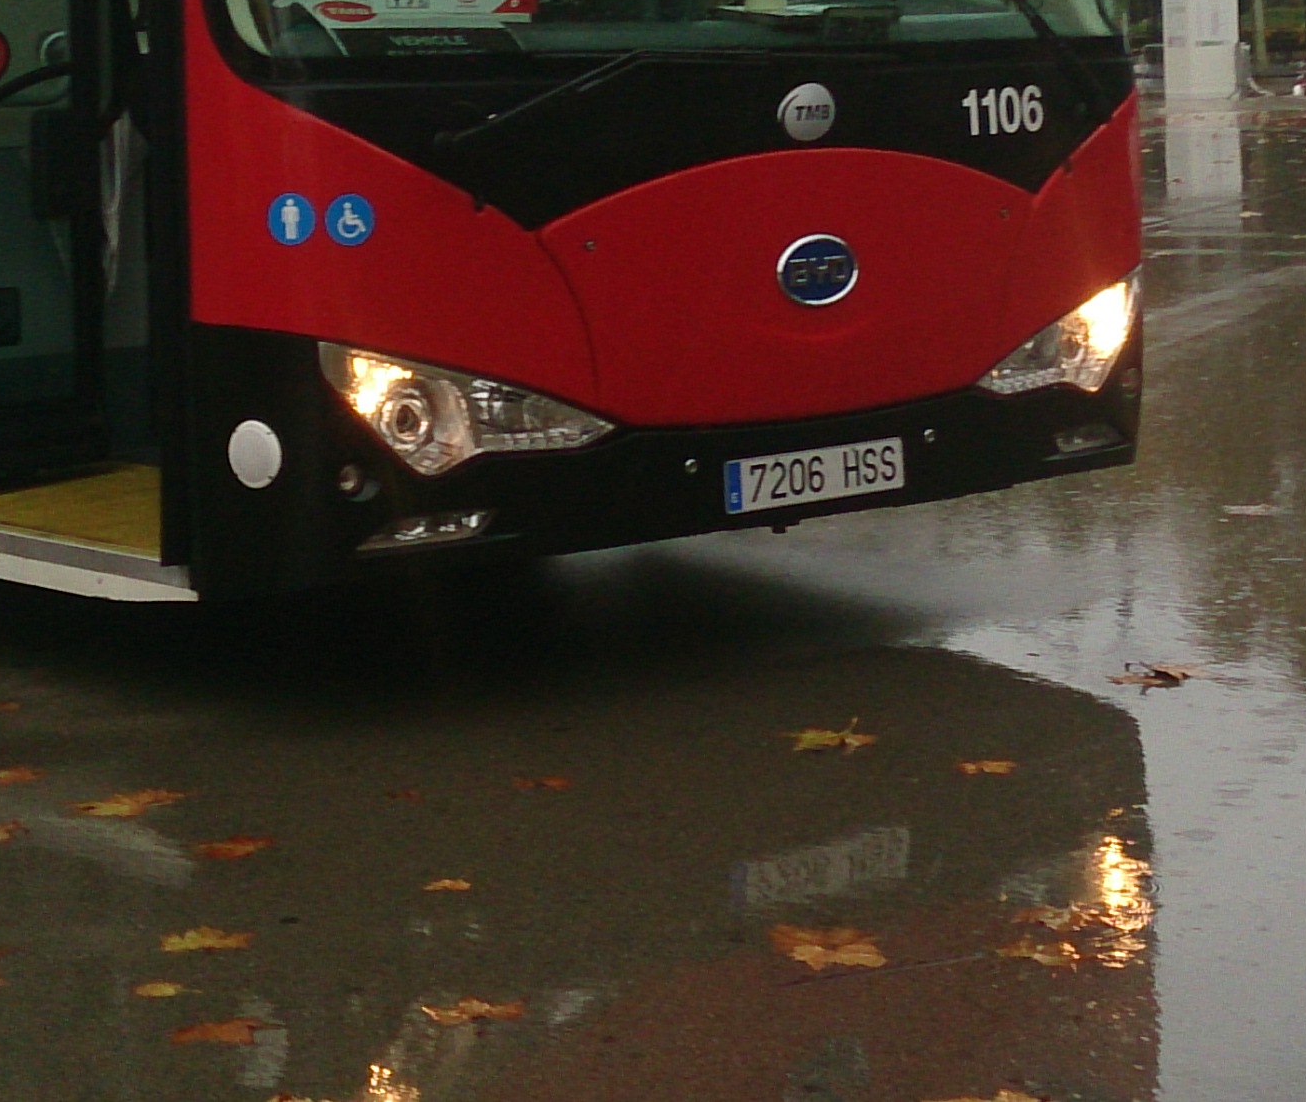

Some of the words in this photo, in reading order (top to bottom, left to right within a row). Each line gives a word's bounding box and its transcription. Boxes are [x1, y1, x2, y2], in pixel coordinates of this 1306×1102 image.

[795, 104, 831, 122] TMB
[961, 84, 1044, 137] 1106
[749, 455, 825, 503] 7206
[843, 445, 897, 488] HSS
